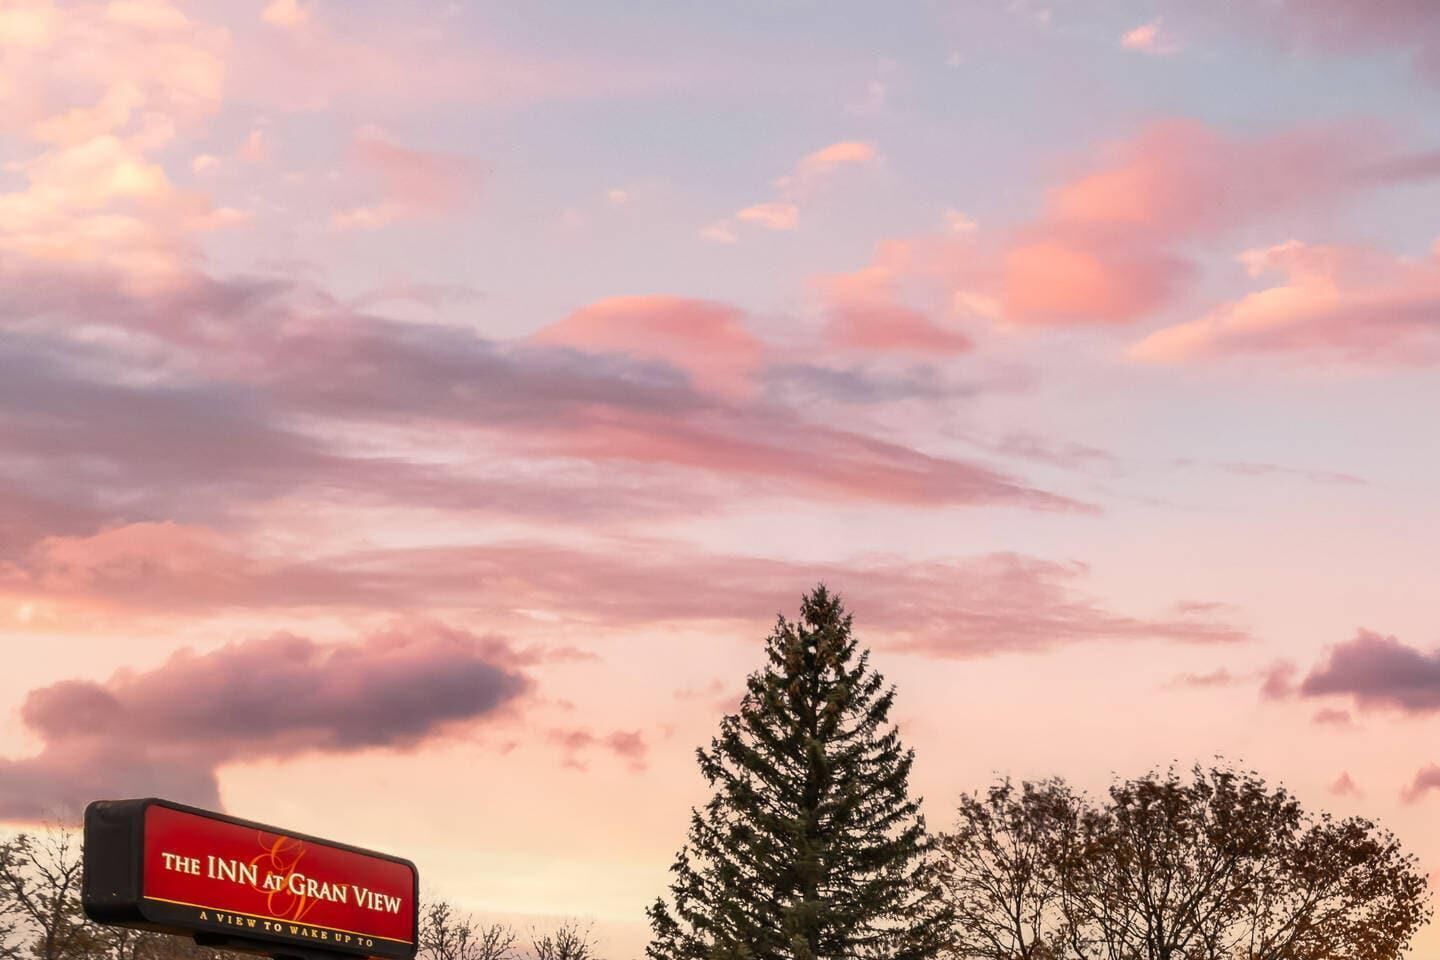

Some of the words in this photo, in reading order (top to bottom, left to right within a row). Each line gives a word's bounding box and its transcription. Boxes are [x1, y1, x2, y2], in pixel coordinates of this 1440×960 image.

[161, 852, 201, 876] THE
[207, 855, 258, 888] INN
[262, 873, 284, 892] AT
[288, 873, 347, 905] GRAN
[352, 885, 402, 915] VIEW
[200, 911, 208, 921] A
[216, 913, 256, 928] VIEW
[264, 921, 282, 932] TO
[289, 925, 328, 940] WAKE
[335, 933, 351, 943] UP
[358, 937, 373, 947] TO
